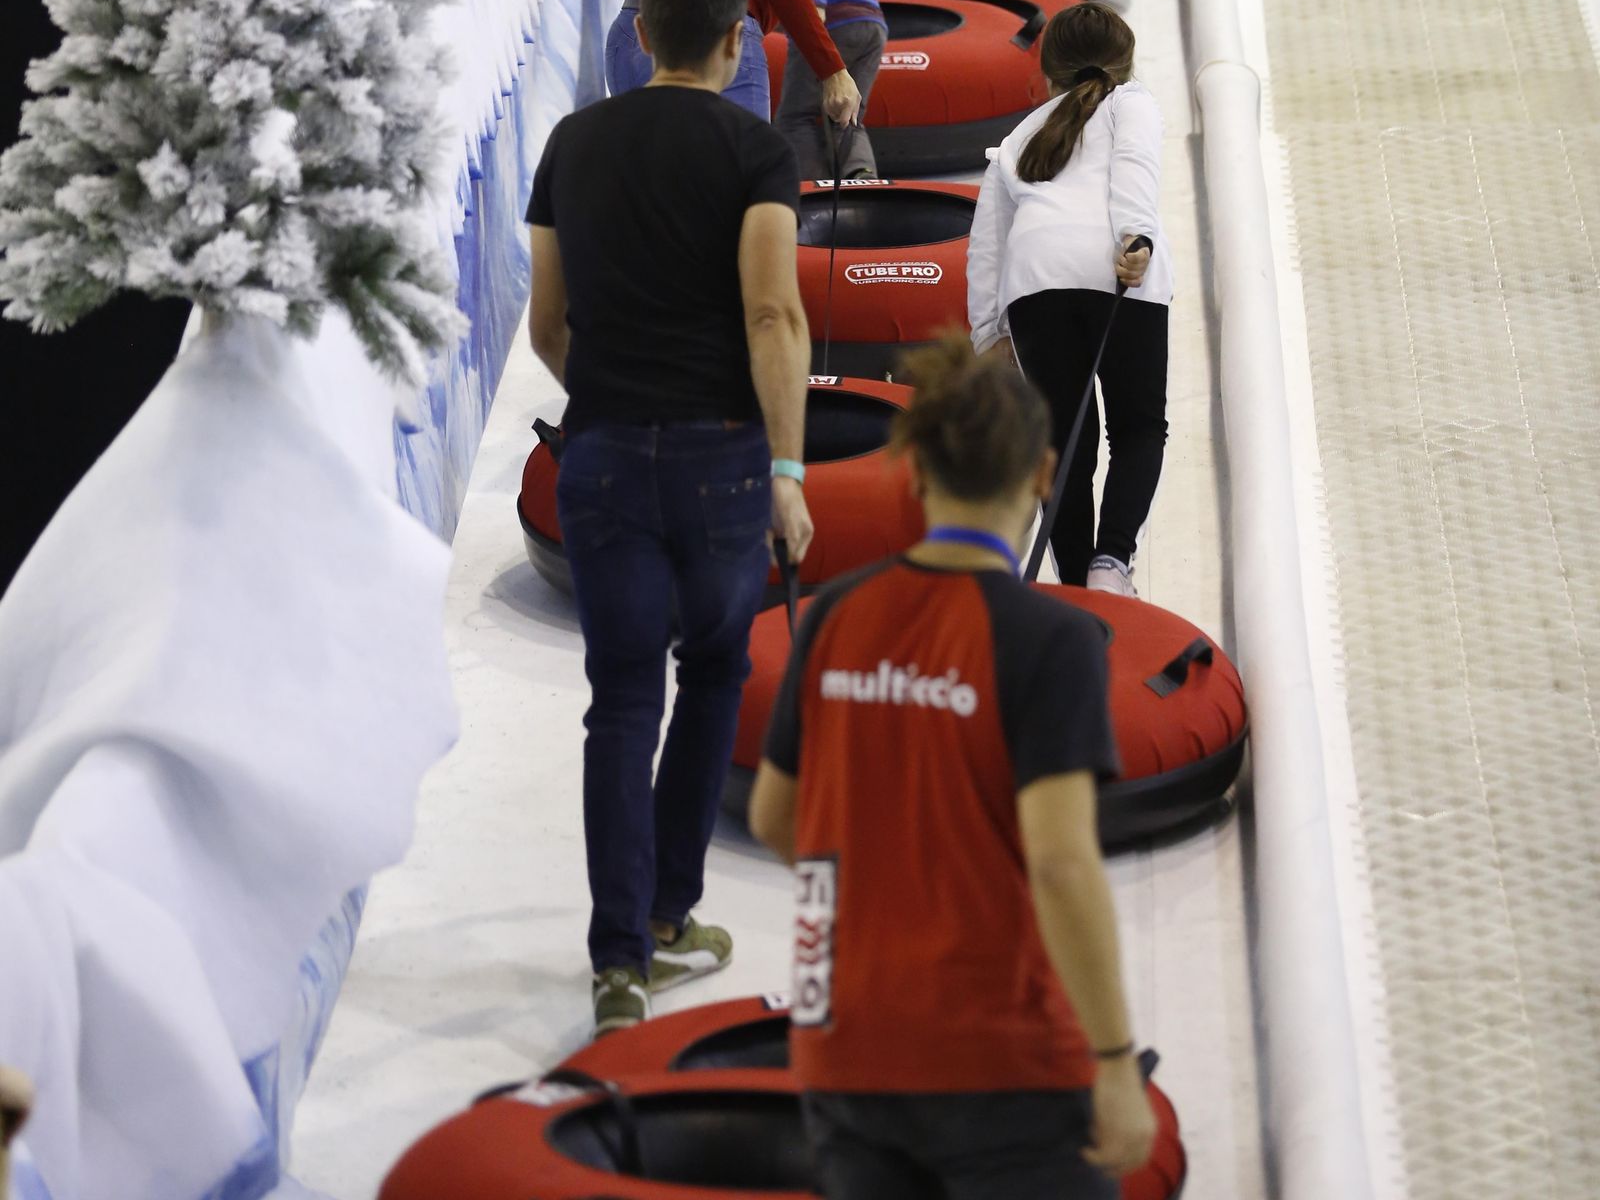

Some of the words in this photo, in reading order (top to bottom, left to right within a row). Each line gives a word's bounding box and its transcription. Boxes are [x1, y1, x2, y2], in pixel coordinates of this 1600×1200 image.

[893, 55, 923, 64] PRO
[852, 267, 899, 277] TUBE
[901, 267, 935, 276] PRO
